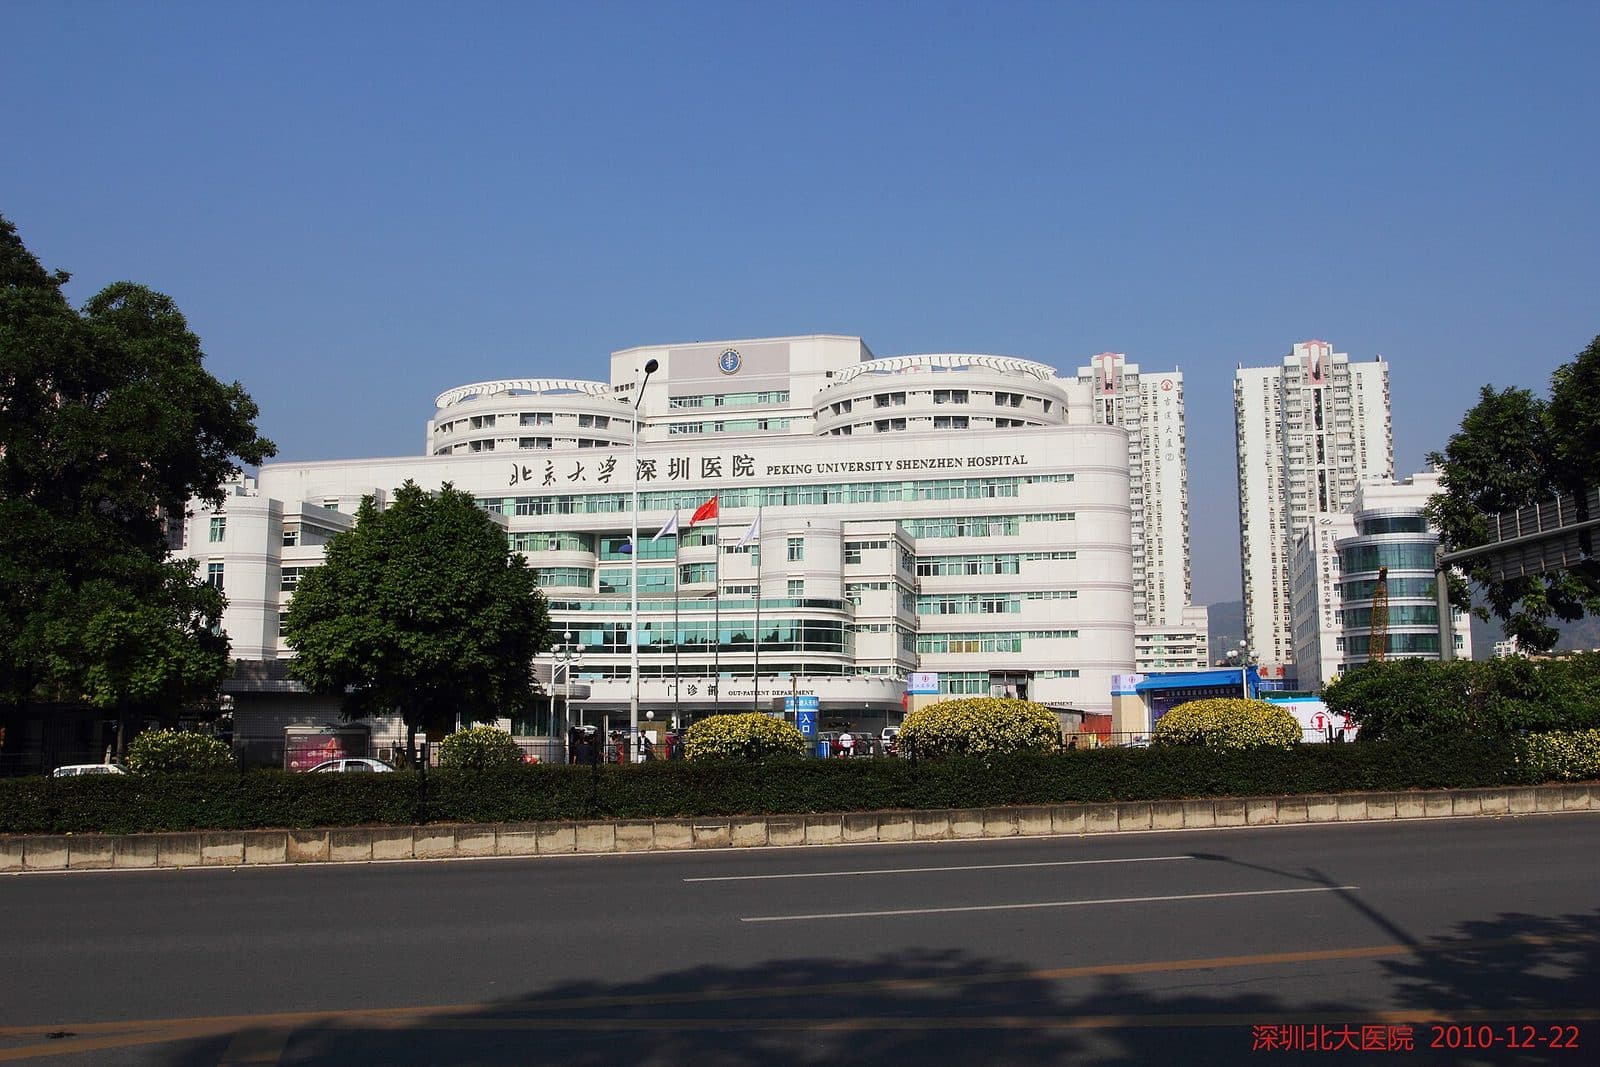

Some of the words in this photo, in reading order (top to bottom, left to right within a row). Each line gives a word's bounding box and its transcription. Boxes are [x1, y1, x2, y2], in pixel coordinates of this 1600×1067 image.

[766, 464, 813, 476] PEKING
[816, 460, 893, 474] UNIVERSITY
[896, 457, 963, 470] SHENZHEN
[966, 454, 1028, 467] HOSPITAL
[801, 713, 811, 733] 入口
